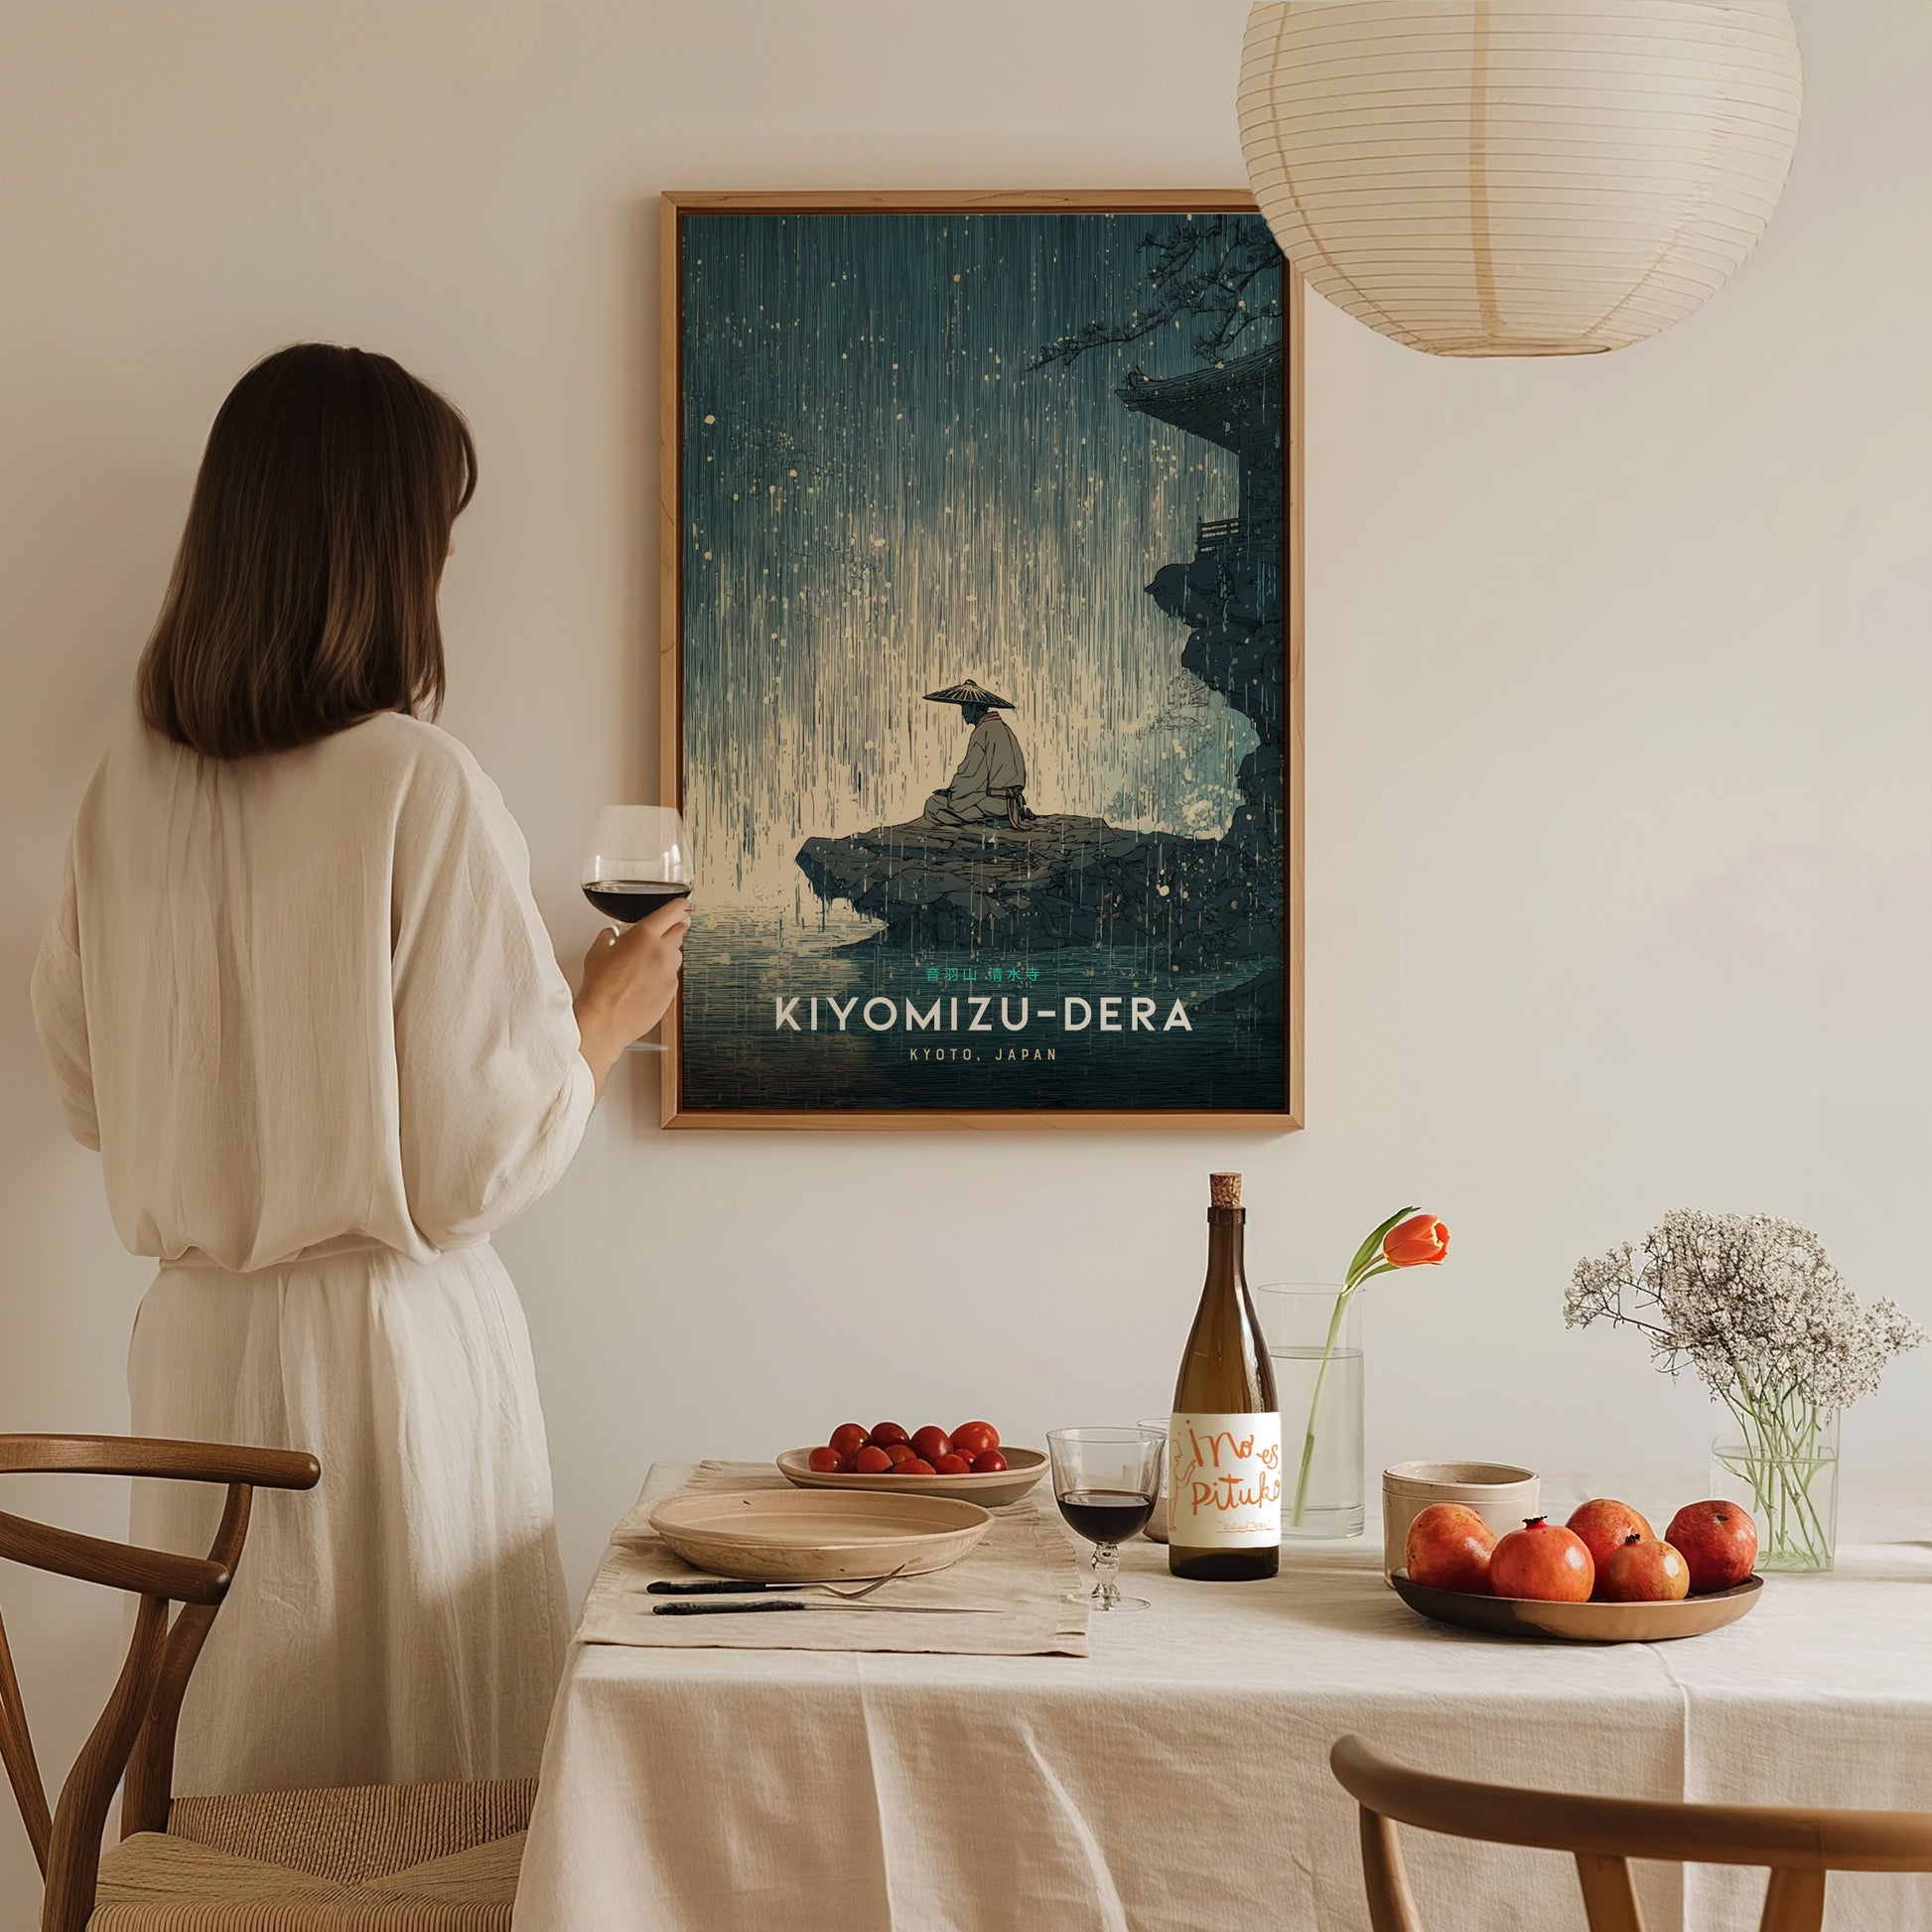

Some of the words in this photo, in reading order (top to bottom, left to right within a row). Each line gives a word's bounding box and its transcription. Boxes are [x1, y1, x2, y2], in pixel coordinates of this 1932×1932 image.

[925, 966, 977, 982] 音羽山
[988, 966, 1040, 982] 清水寺
[775, 997, 1193, 1032] KIYOMIZU-DERA
[909, 1048, 981, 1062] KYOTO,
[995, 1048, 1057, 1061] JAPAN
[1256, 1444, 1279, 1469] es
